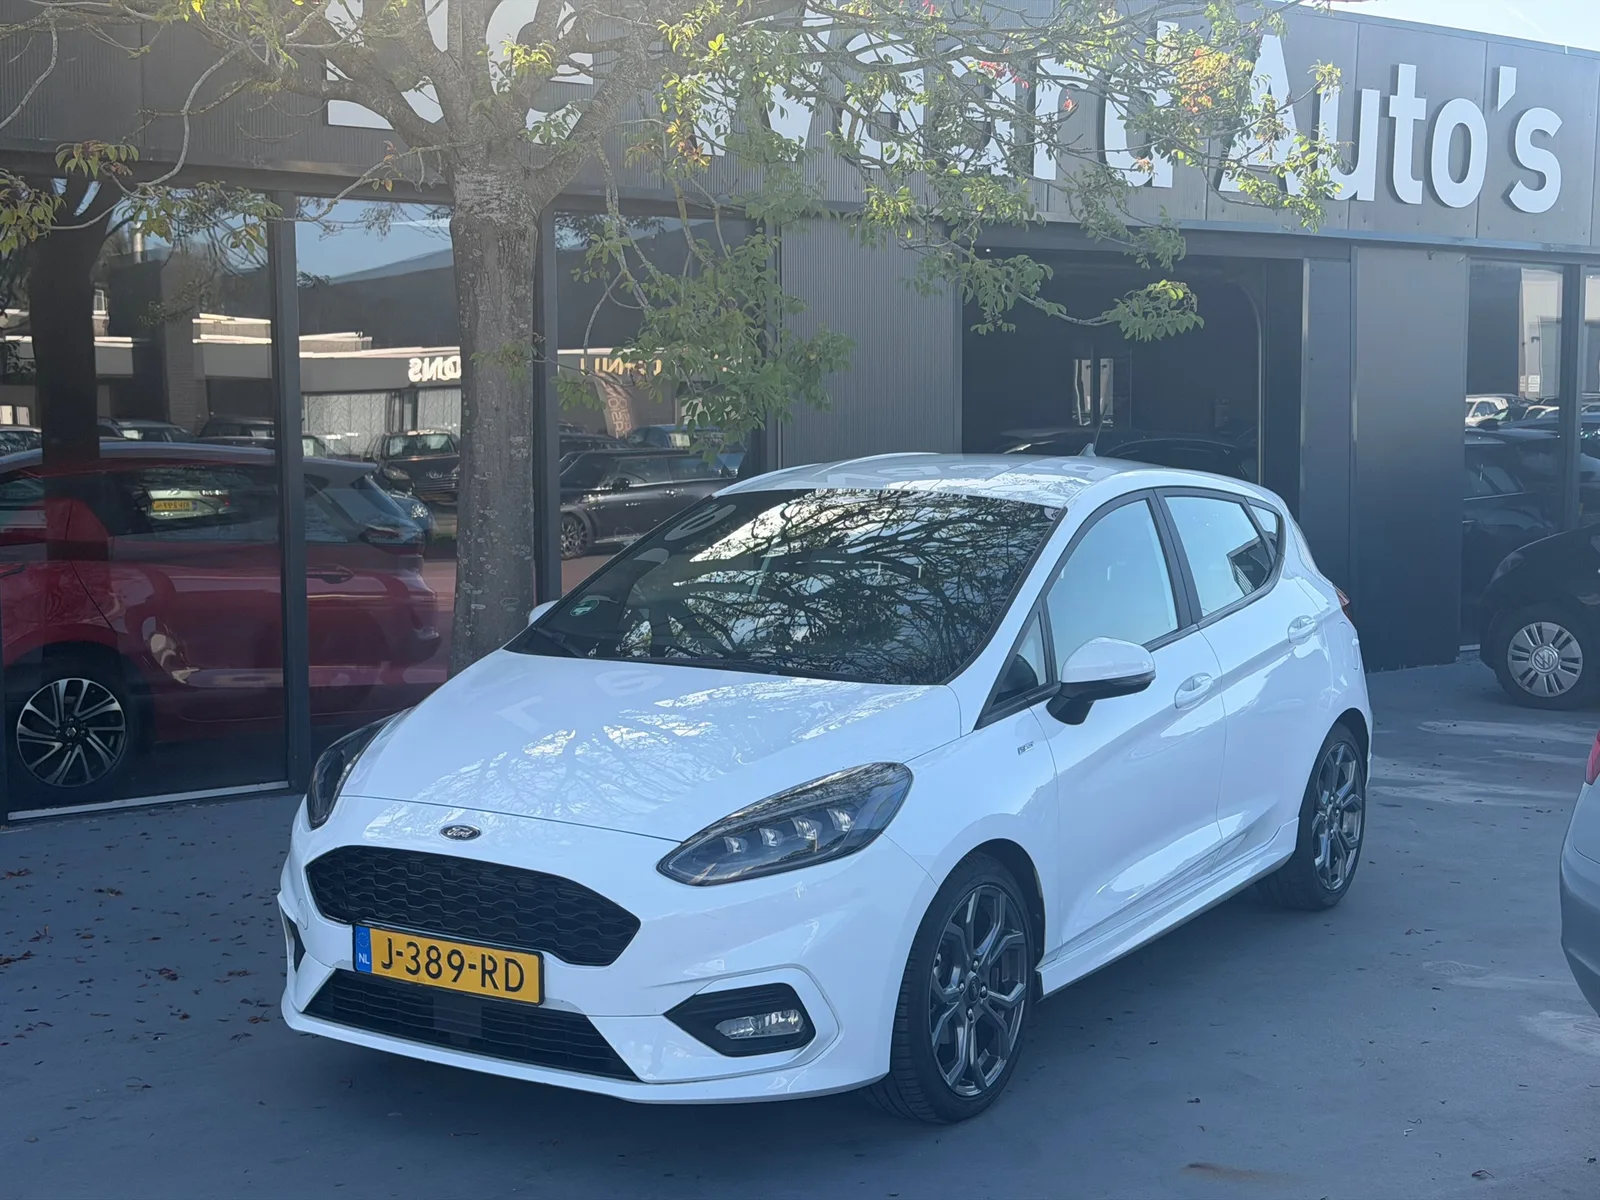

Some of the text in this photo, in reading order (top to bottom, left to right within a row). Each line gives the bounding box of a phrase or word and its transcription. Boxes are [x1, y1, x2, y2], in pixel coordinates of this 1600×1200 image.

[1218, 34, 1563, 214] Auto's
[446, 824, 474, 838] Ford
[358, 952, 371, 965] NL
[381, 937, 525, 993] J-389-RD
